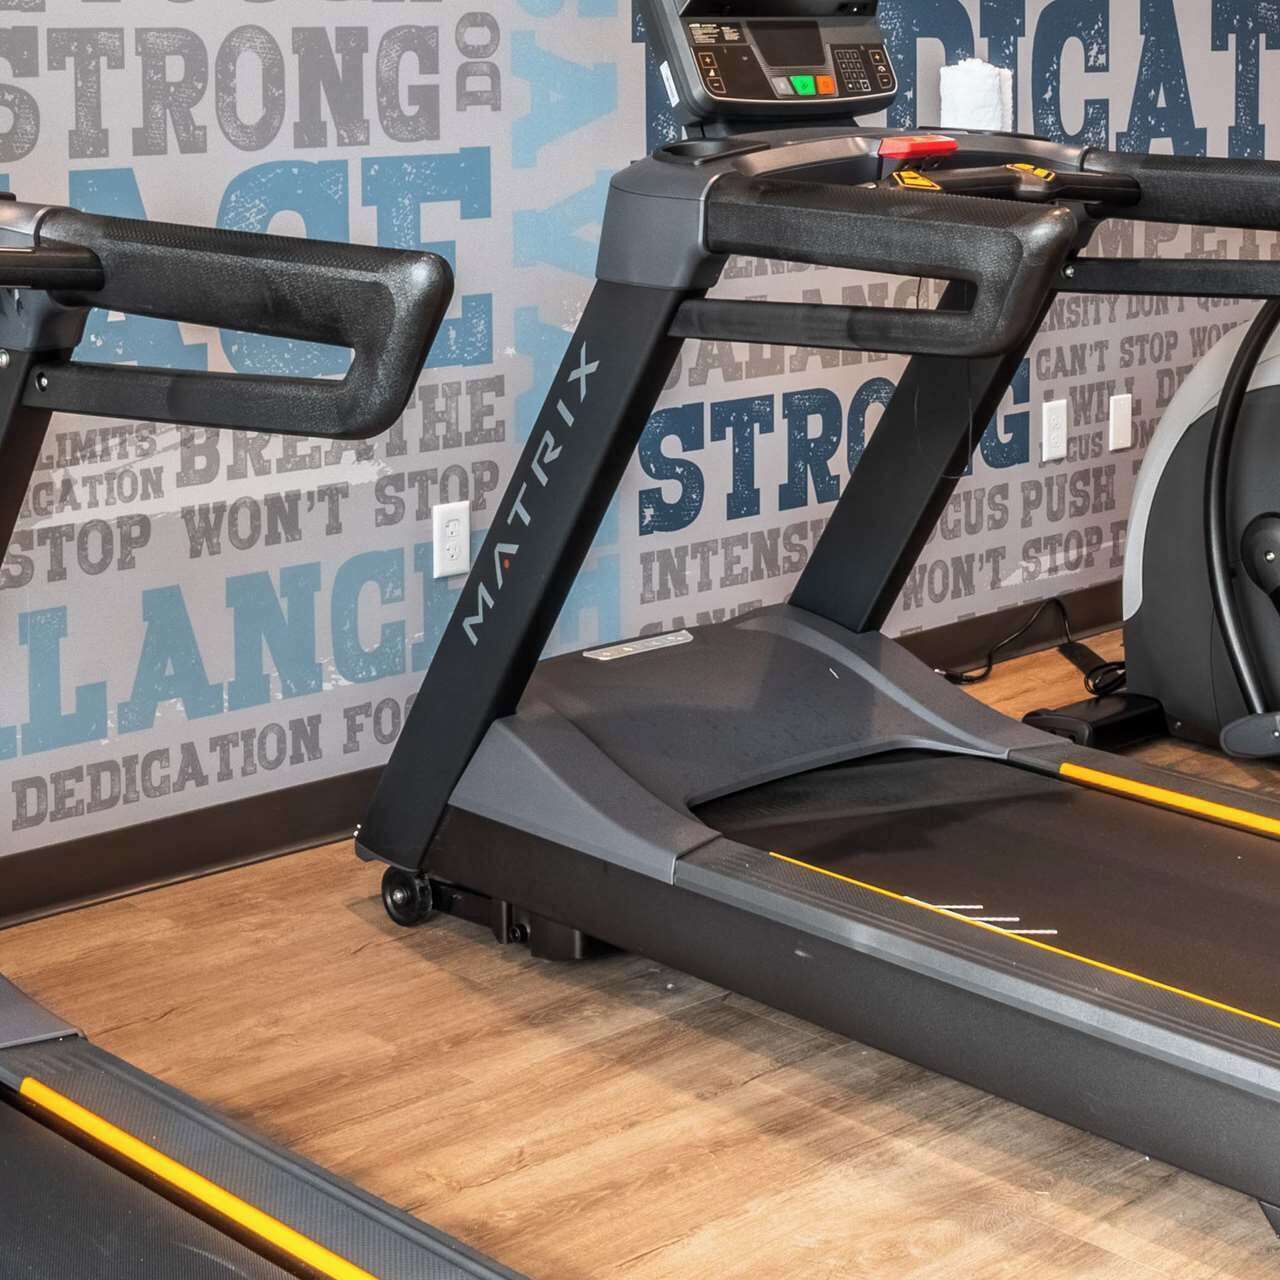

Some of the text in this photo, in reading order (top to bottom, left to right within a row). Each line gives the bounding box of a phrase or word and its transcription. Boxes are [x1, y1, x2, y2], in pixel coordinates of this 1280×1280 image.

[455, 11, 502, 112] DO
[1035, 340, 1109, 381] CAN'T
[1120, 330, 1178, 369] STOP
[182, 483, 350, 559] WON'T
[375, 461, 503, 528] STOP
[463, 341, 601, 647] MATRIX
[1021, 464, 1116, 529] PUSH
[639, 517, 830, 605] INTENS
[1022, 524, 1103, 585] STOP
[11, 714, 324, 832] DEDICATION
